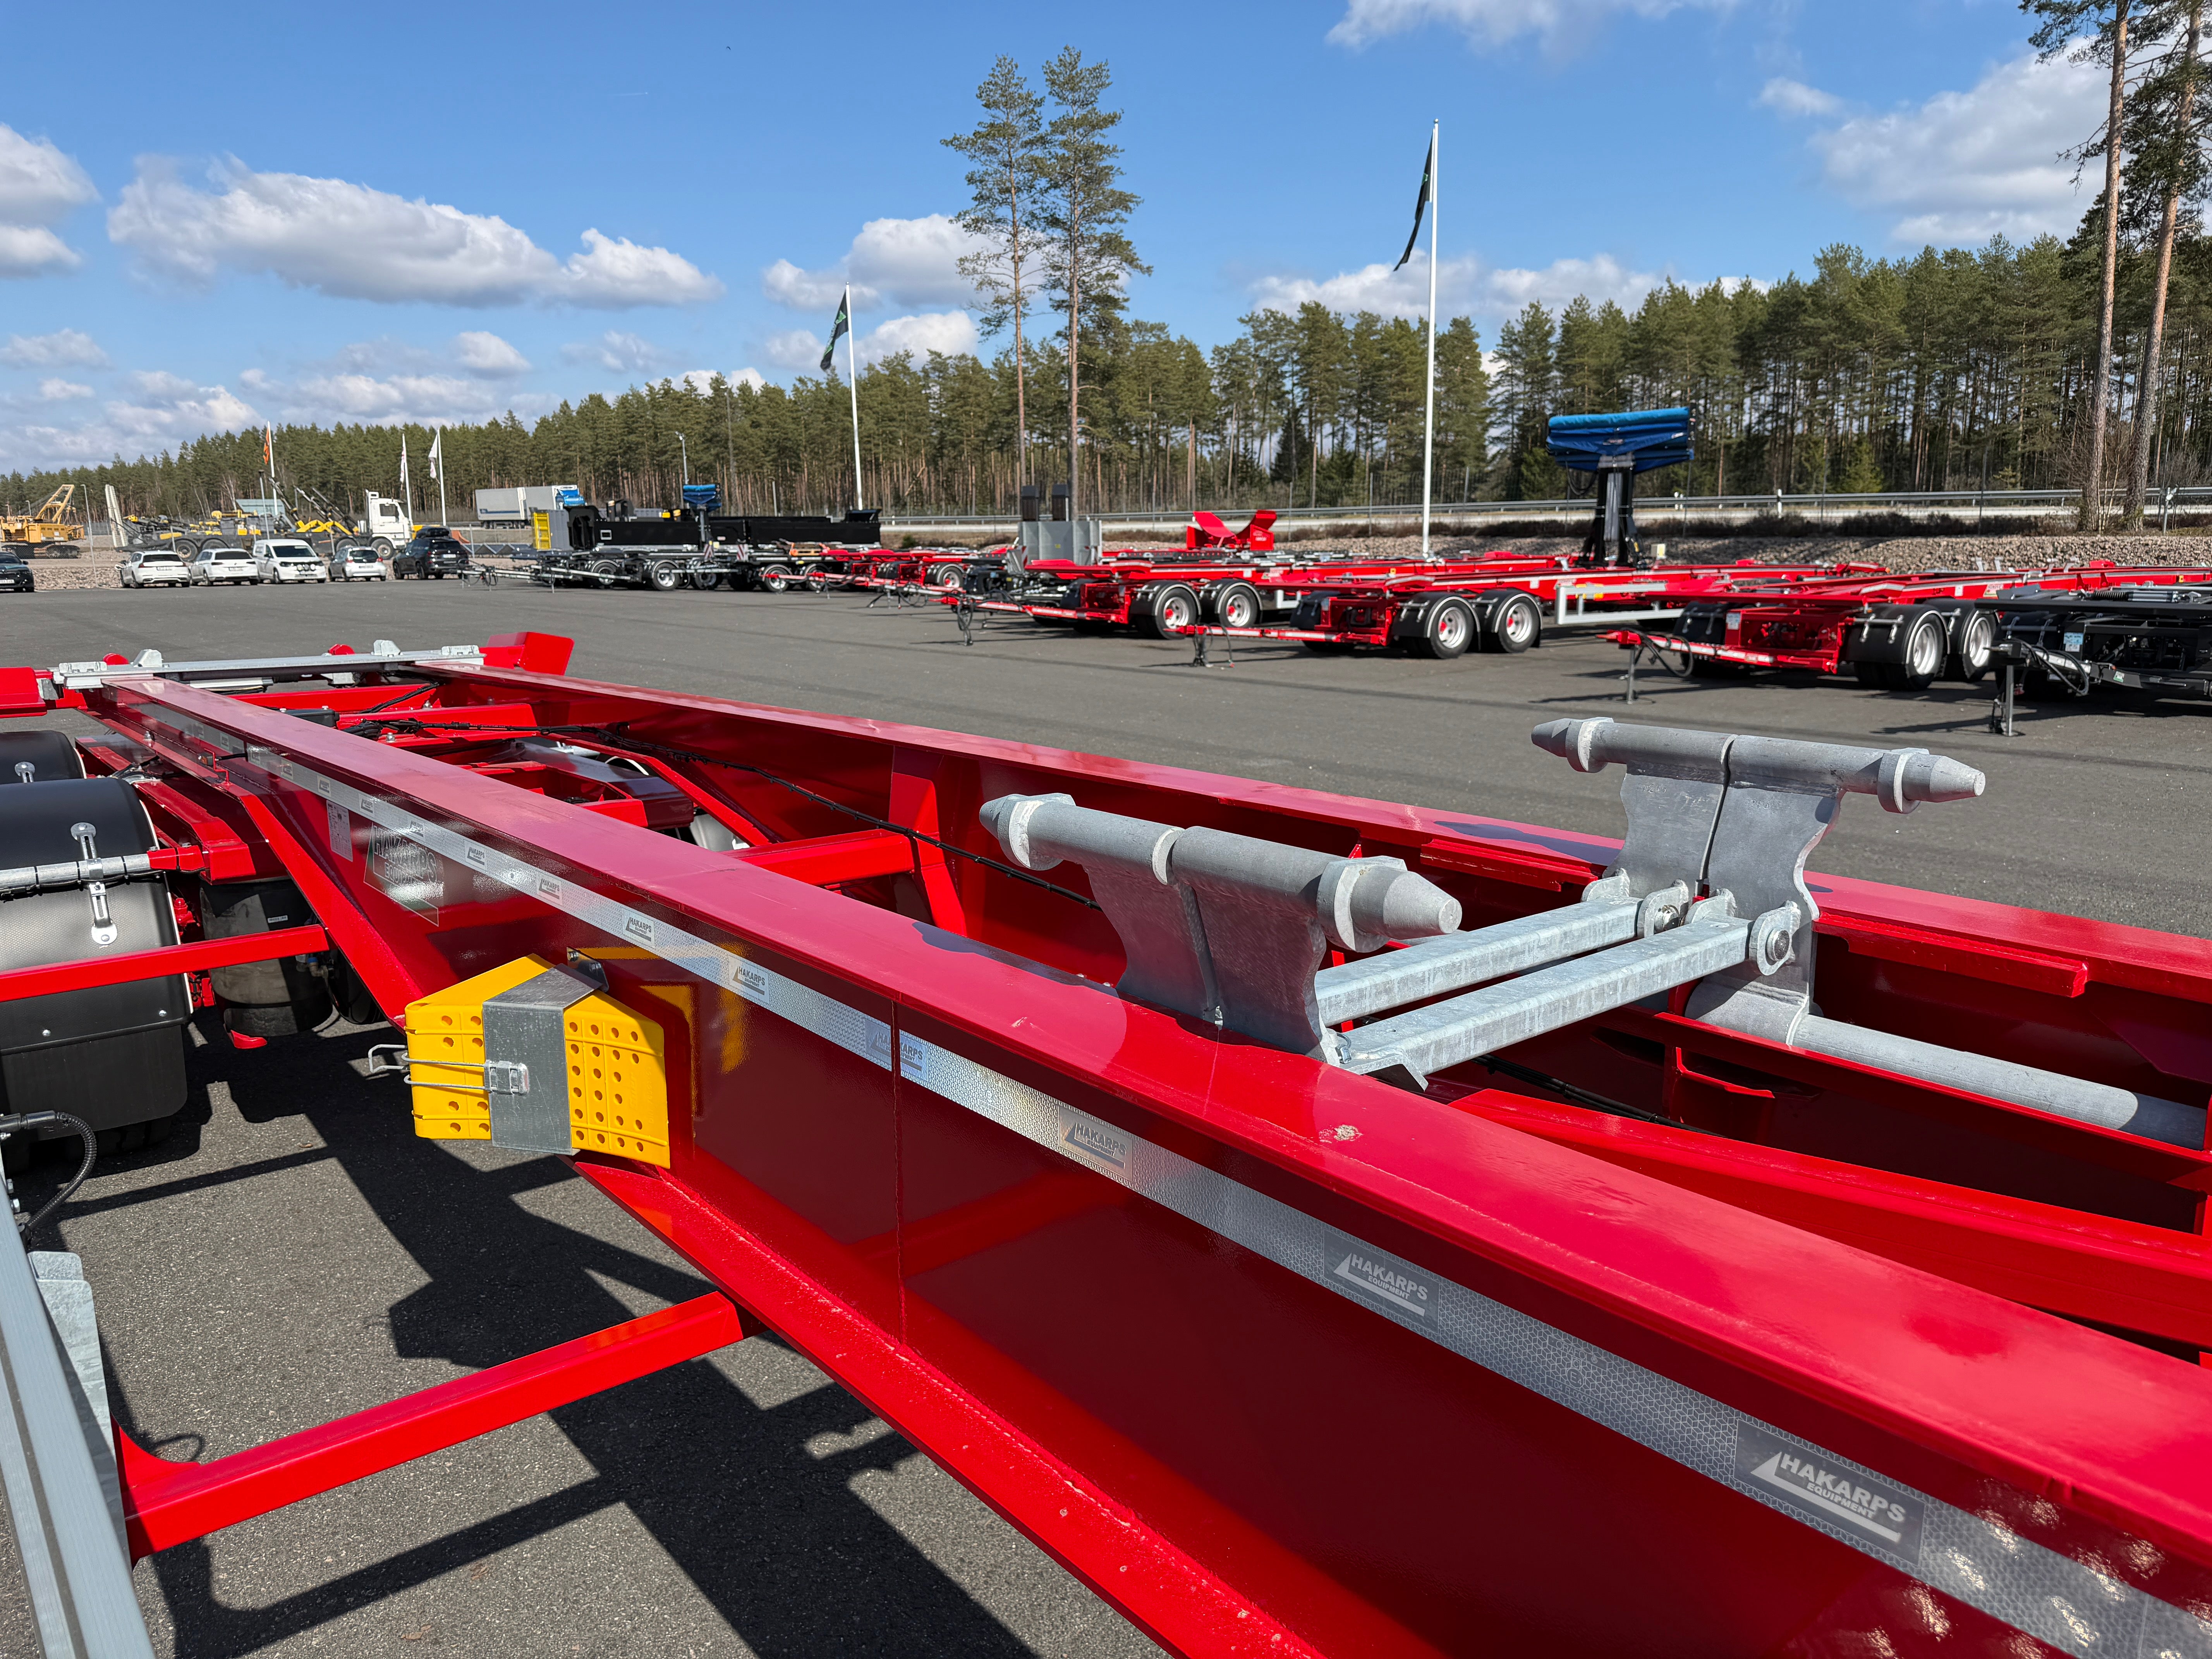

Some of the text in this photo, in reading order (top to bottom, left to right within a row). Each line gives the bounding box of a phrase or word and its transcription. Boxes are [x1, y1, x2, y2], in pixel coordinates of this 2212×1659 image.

[542, 878, 560, 891] HAKARPS
[630, 917, 651, 933] HAKARPS
[738, 966, 765, 986] HAKARPS
[1076, 1123, 1127, 1156] HAKARPS
[1351, 1254, 1428, 1300] HAKARPS
[1368, 1275, 1410, 1300] EQUIPMENT
[1556, 1340, 1590, 1364] ORAFOL
[1550, 1379, 1563, 1391] 104
[1780, 1453, 1906, 1522] HAKARPS
[1807, 1482, 1875, 1518] EQUIPMENT
